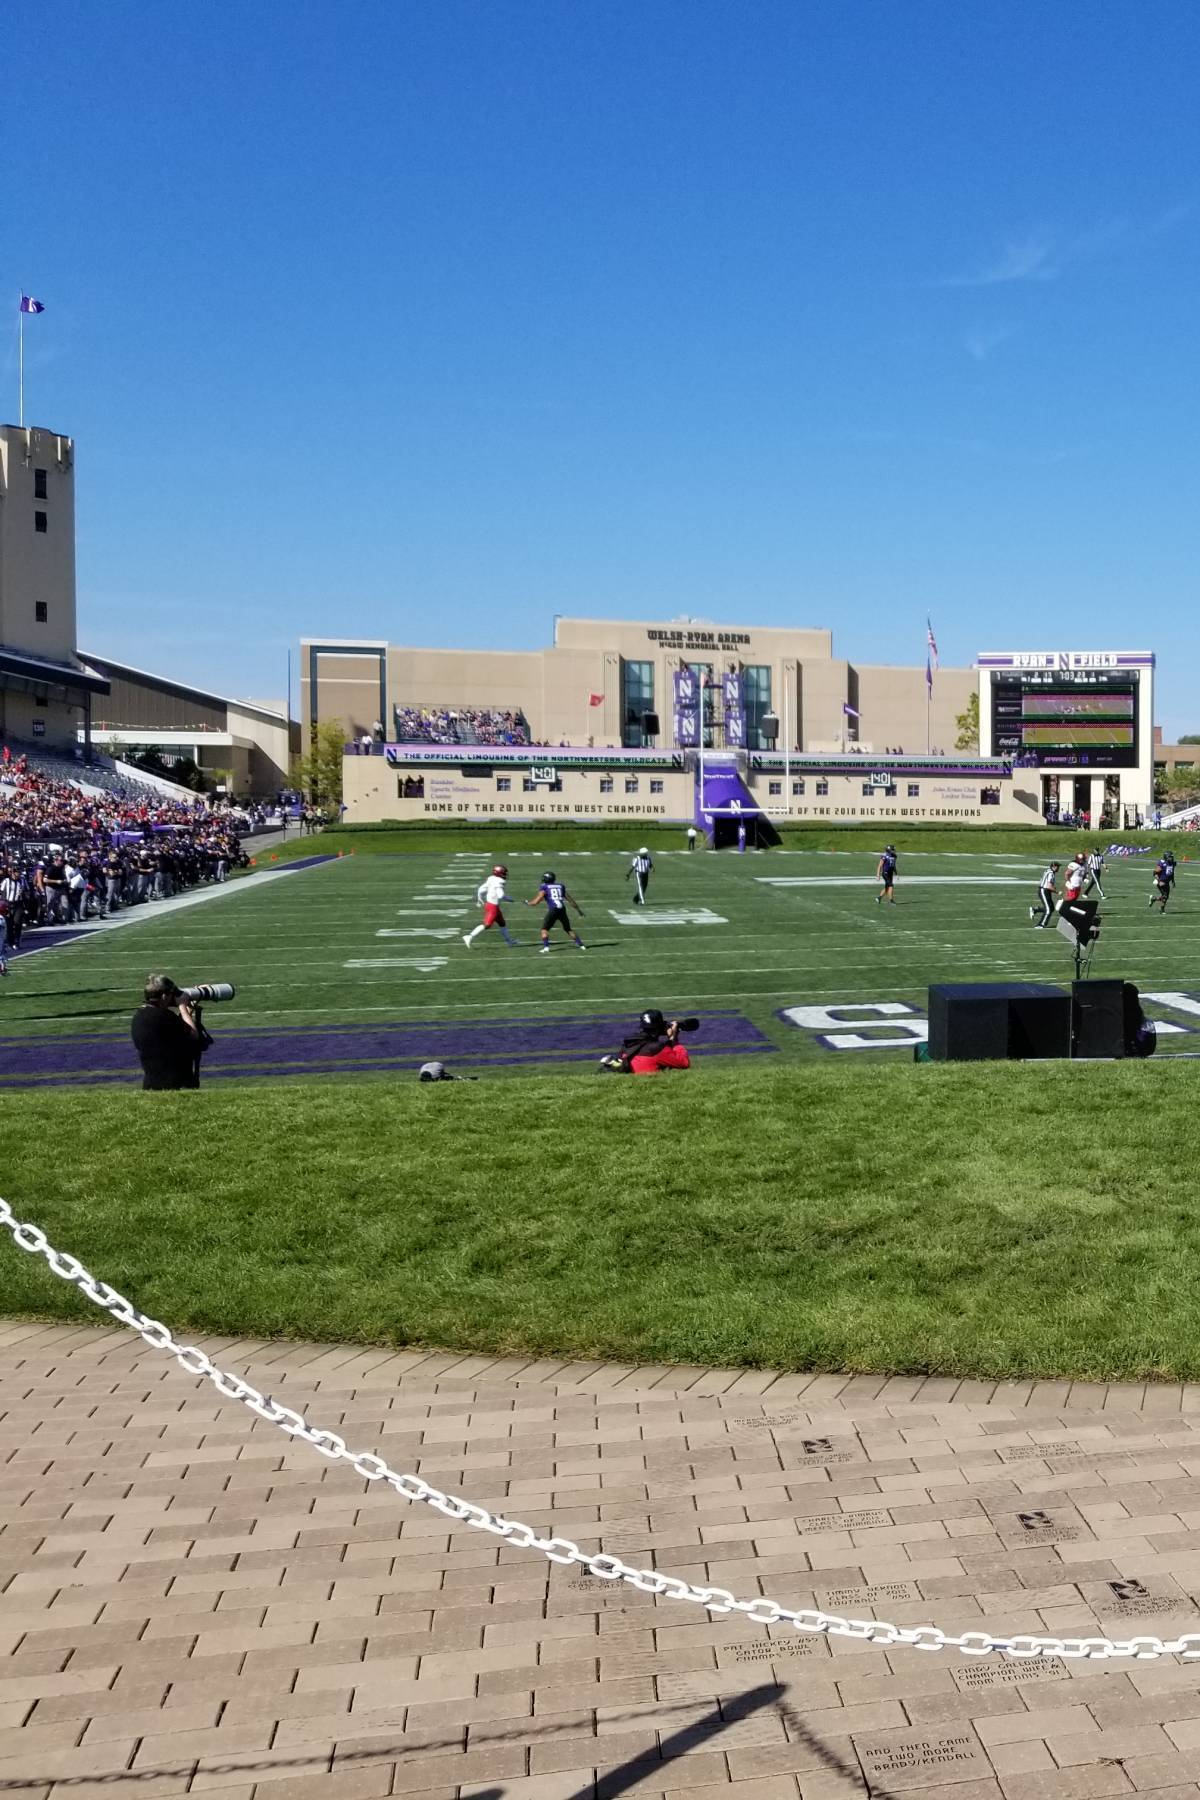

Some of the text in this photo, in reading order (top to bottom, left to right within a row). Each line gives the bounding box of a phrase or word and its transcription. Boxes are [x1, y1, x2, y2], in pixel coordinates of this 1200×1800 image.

[648, 630, 750, 644] WELSH-RYAN ARENA
[686, 643, 720, 651] MEMORIAL
[1013, 655, 1046, 667] RYAN
[1080, 655, 1117, 667] FIELD
[424, 804, 453, 812] HOME
[457, 804, 470, 812] OF
[475, 804, 495, 812] THE
[500, 804, 523, 812] 2018
[528, 804, 545, 812] BIG
[608, 805, 665, 813] CHAMPIONS
[797, 807, 809, 815] OF
[813, 807, 831, 815] THE
[930, 809, 981, 817] CHAMPIONS
[550, 888, 563, 900] 81
[824, 1584, 907, 1597] TIMMY VERNON
[828, 1598, 878, 1607] FOOTBALL
[753, 1640, 790, 1649] HICKEY
[780, 1644, 811, 1652] BOWL
[736, 1654, 782, 1663] CHAMPS
[957, 1657, 1055, 1674] CINDY GALLOWAY
[959, 1669, 1016, 1681] CHAMPION
[1022, 1665, 1046, 1673] WIFE
[1002, 1673, 1039, 1682] TENNIS
[866, 1737, 973, 1757] AND THEN CAME
[888, 1747, 959, 1761] TWO MORE
[874, 1752, 977, 1771] BRADY/KENDALL
